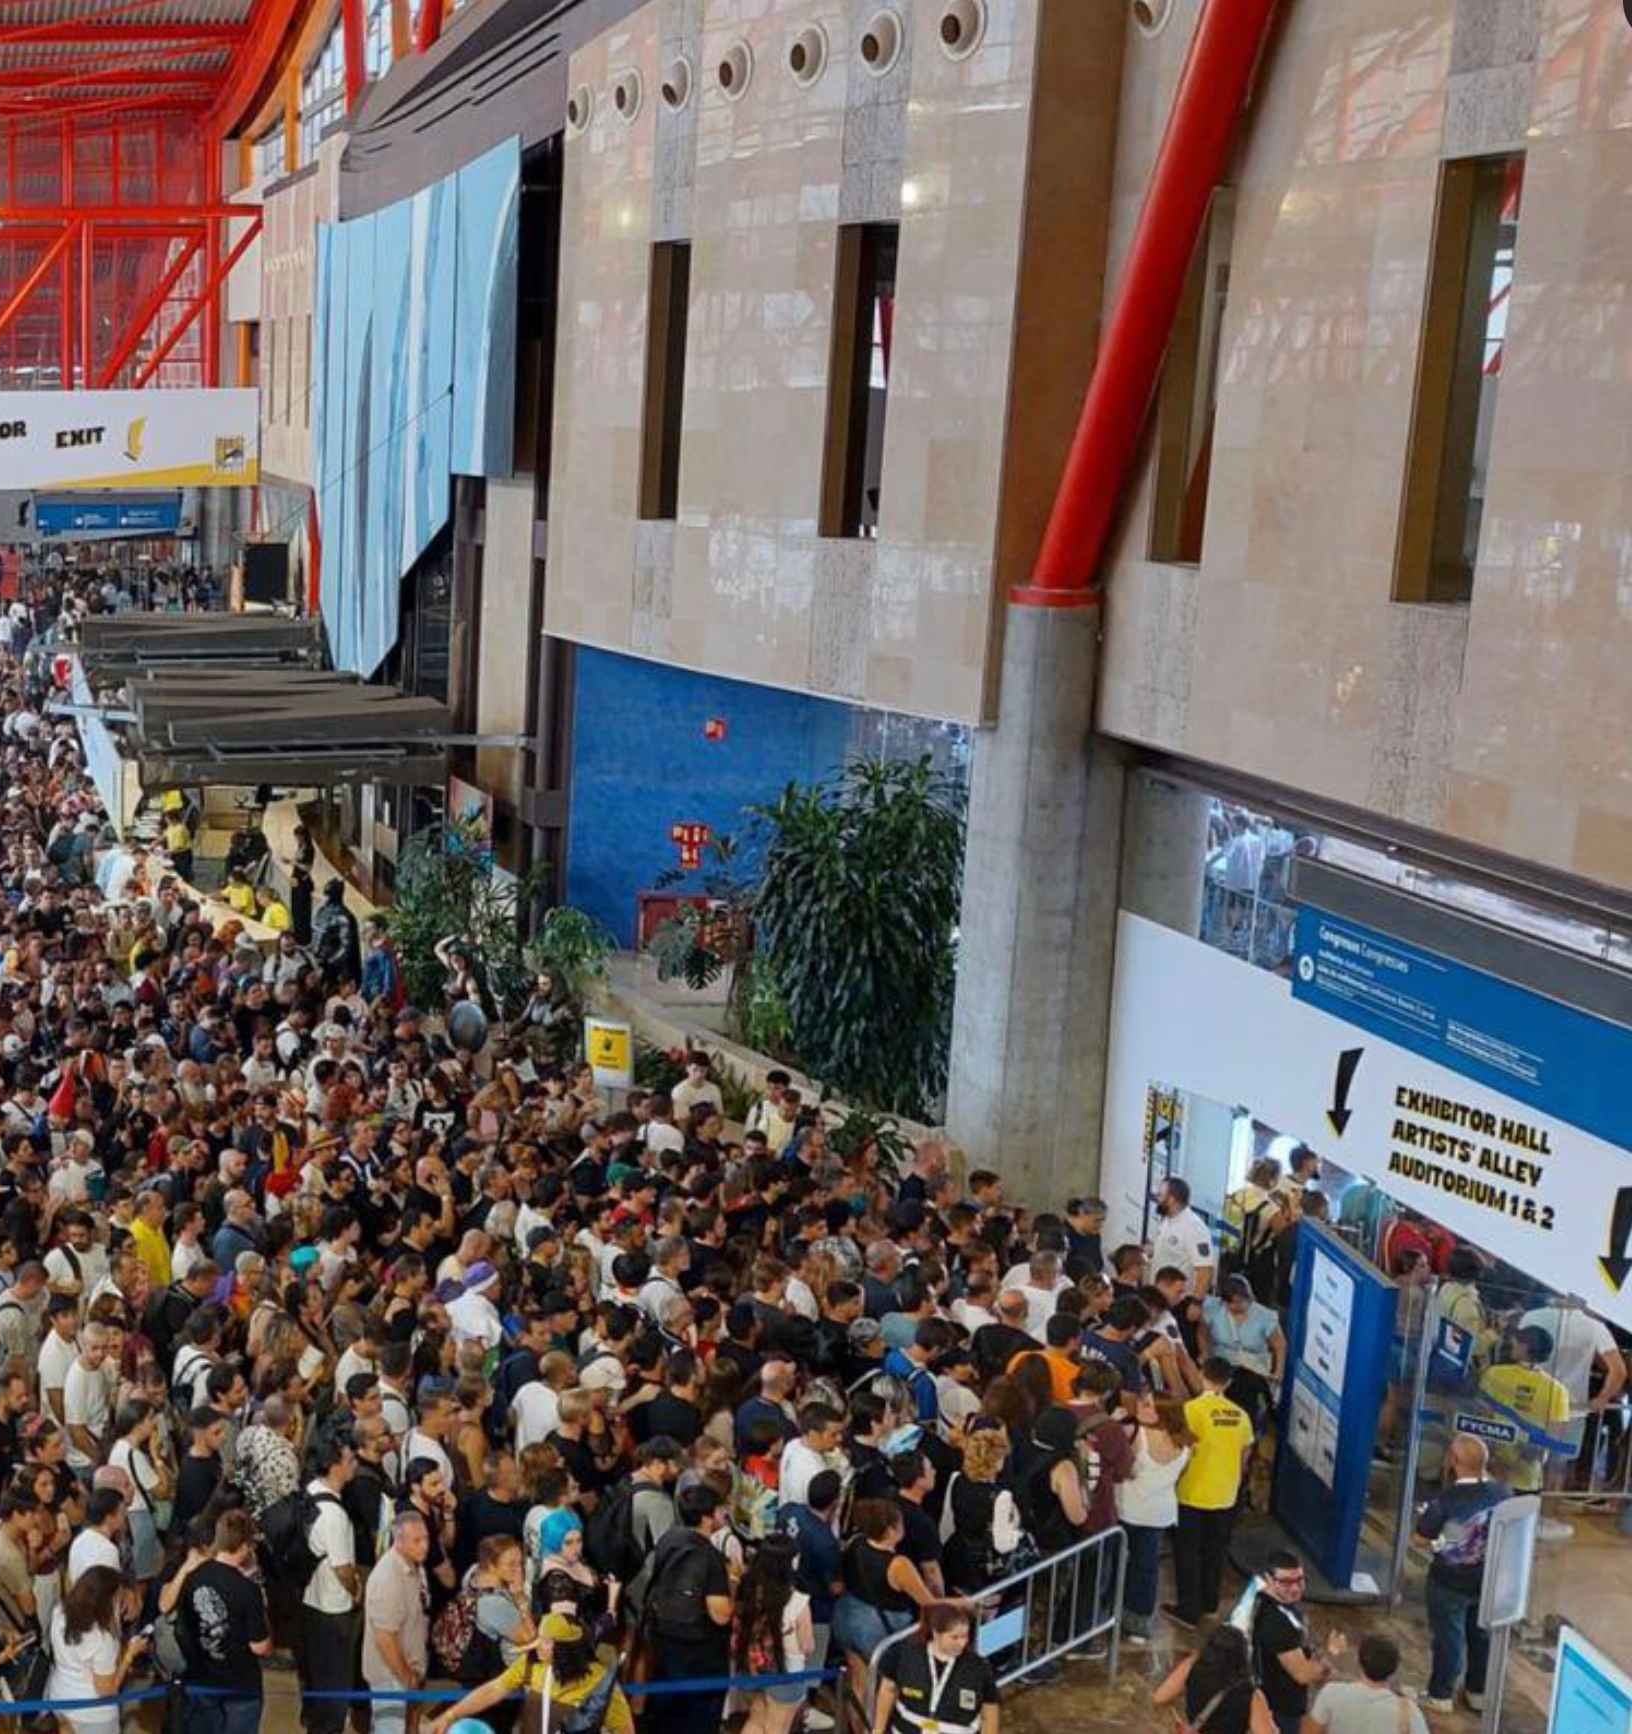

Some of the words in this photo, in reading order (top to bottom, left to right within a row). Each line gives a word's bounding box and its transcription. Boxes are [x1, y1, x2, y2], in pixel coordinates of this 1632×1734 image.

[55, 426, 106, 449] EXIT
[1395, 1085, 1497, 1137] EXHIBITOR
[1499, 1117, 1552, 1156] HALL
[1388, 1151, 1507, 1212] AUDITORIUM
[1392, 1119, 1476, 1163] ARTISTS'
[1478, 1146, 1544, 1187] ALLEY
